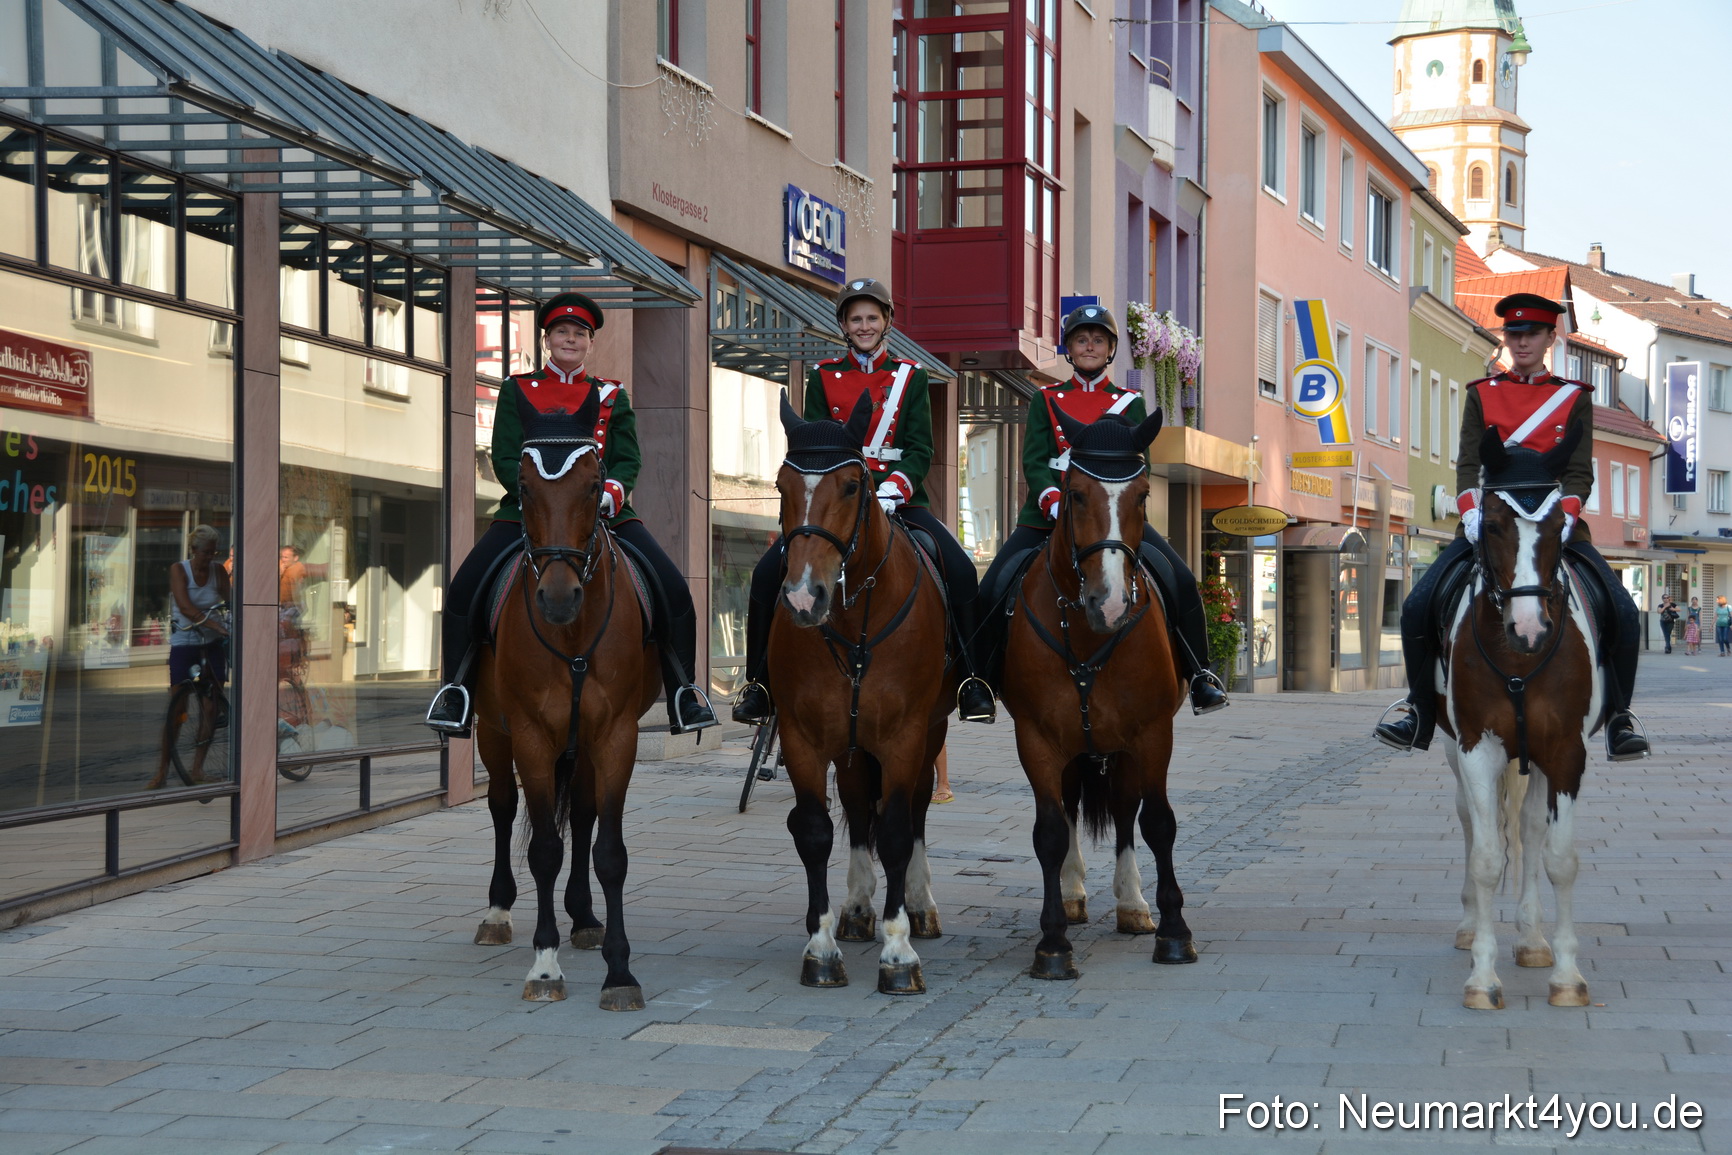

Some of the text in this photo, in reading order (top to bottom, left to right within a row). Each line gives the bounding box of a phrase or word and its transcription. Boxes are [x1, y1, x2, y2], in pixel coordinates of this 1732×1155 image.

[652, 181, 708, 223] Klostergasse 2
[797, 196, 846, 257] CECIL
[1298, 373, 1327, 402] B
[0, 425, 38, 460] es
[1686, 374, 1697, 482] TOM TAILOR
[85, 453, 137, 497] 2015
[1294, 455, 1344, 464] KLOSTERGASSE
[0, 470, 57, 515] ches
